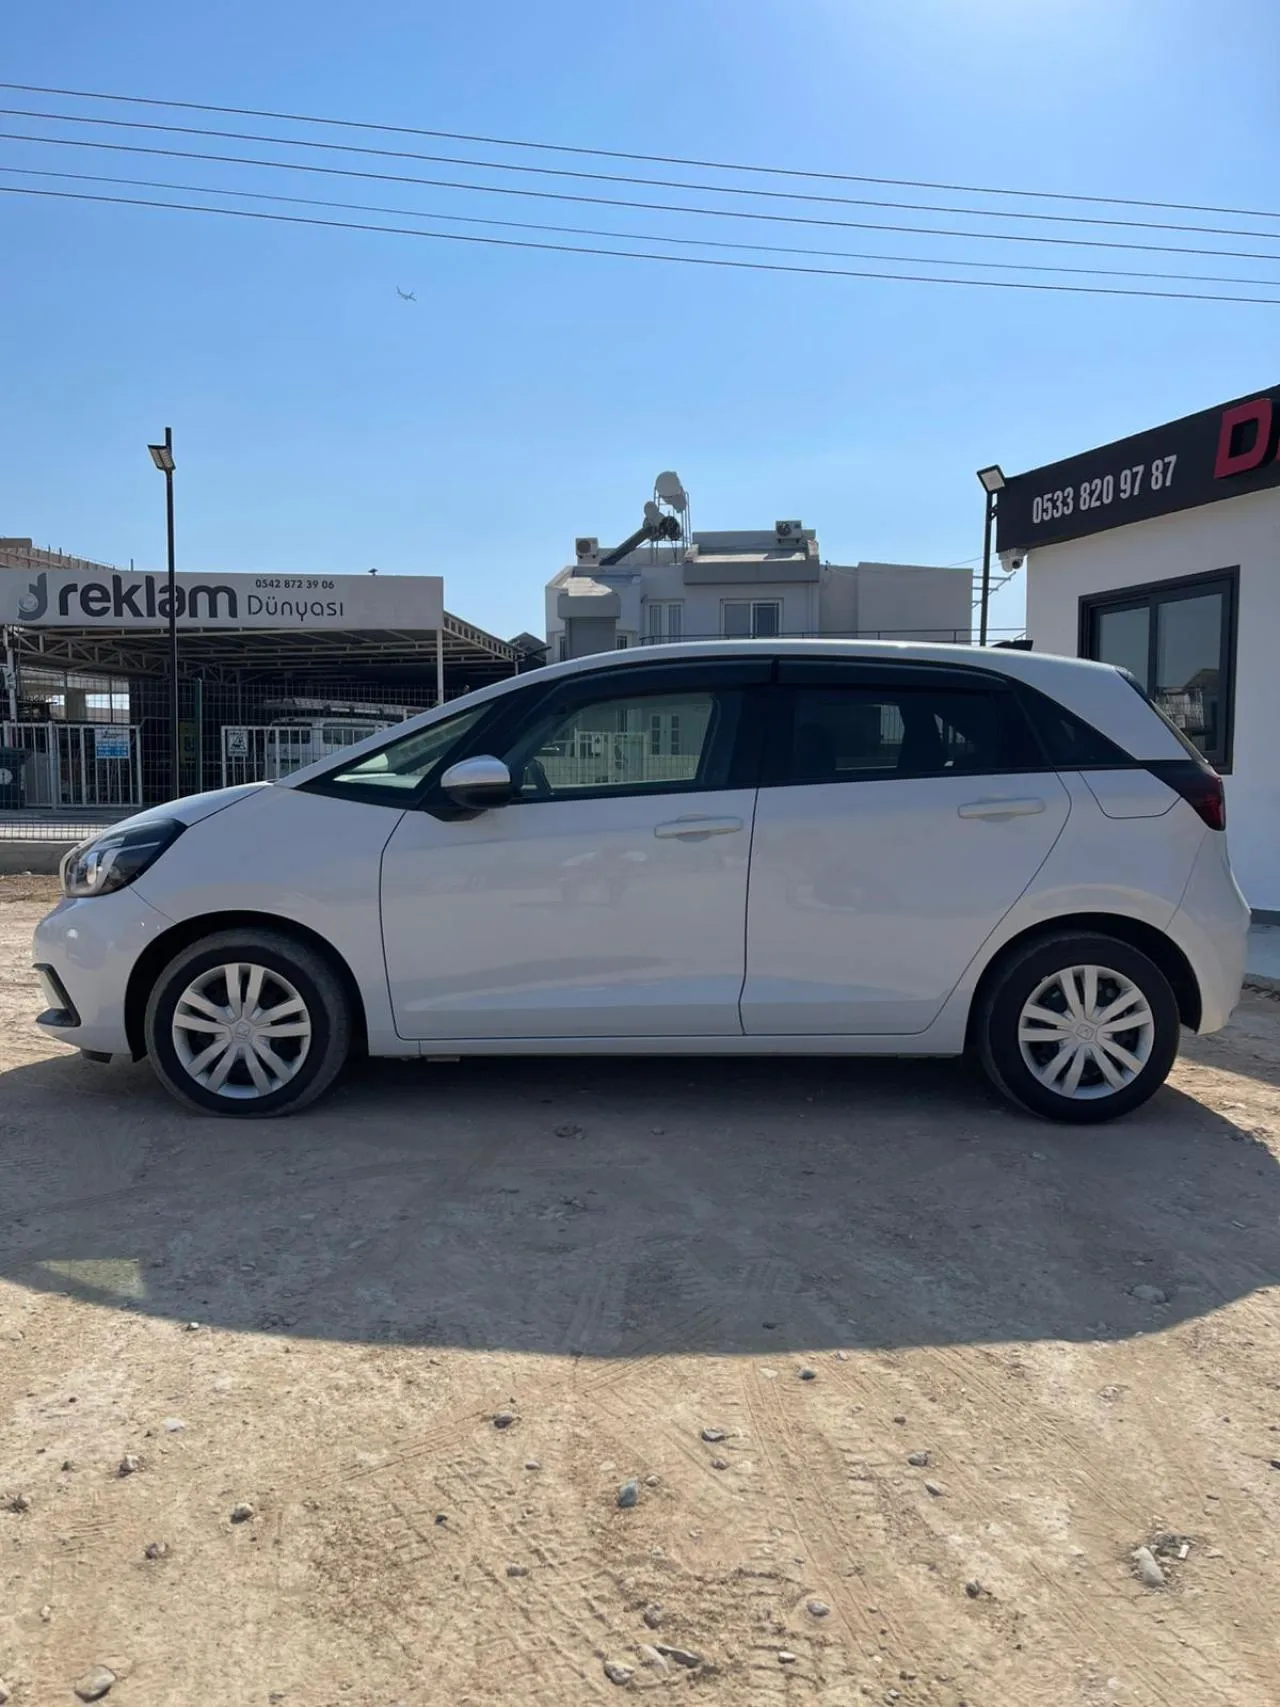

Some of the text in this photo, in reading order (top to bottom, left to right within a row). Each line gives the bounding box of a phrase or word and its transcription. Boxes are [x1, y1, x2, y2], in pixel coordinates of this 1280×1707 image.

[1213, 397, 1280, 479] D
[1032, 454, 1177, 524] 0533 820 97 87
[58, 574, 238, 619] reklam
[255, 578, 335, 590] 0542 872 39 06
[247, 594, 344, 622] Dünyası
